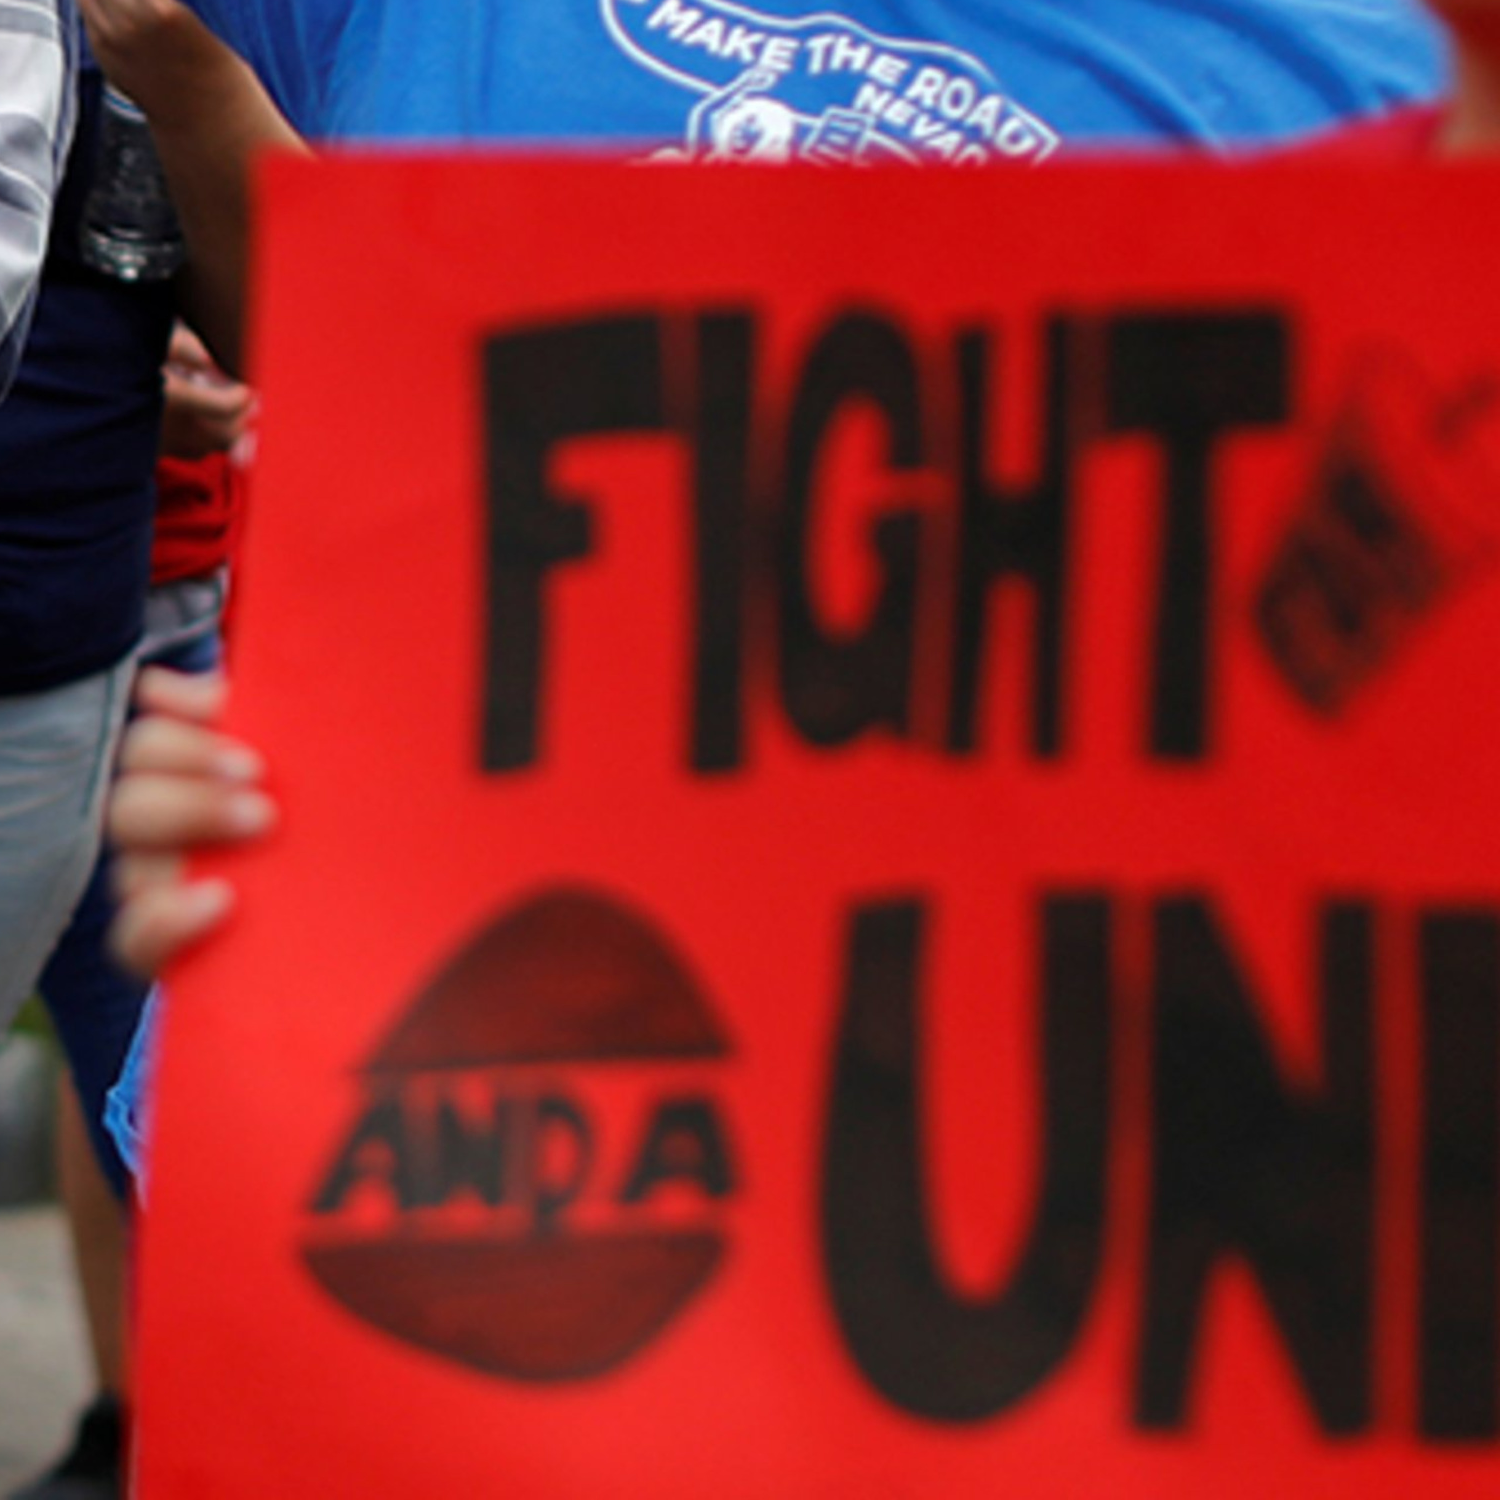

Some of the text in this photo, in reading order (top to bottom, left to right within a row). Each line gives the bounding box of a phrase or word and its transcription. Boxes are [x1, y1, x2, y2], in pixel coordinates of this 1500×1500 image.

[805, 33, 912, 86] THE
[905, 66, 1040, 157] ROAD
[474, 300, 1296, 780] FIGHT
[618, 1092, 740, 1206] A
